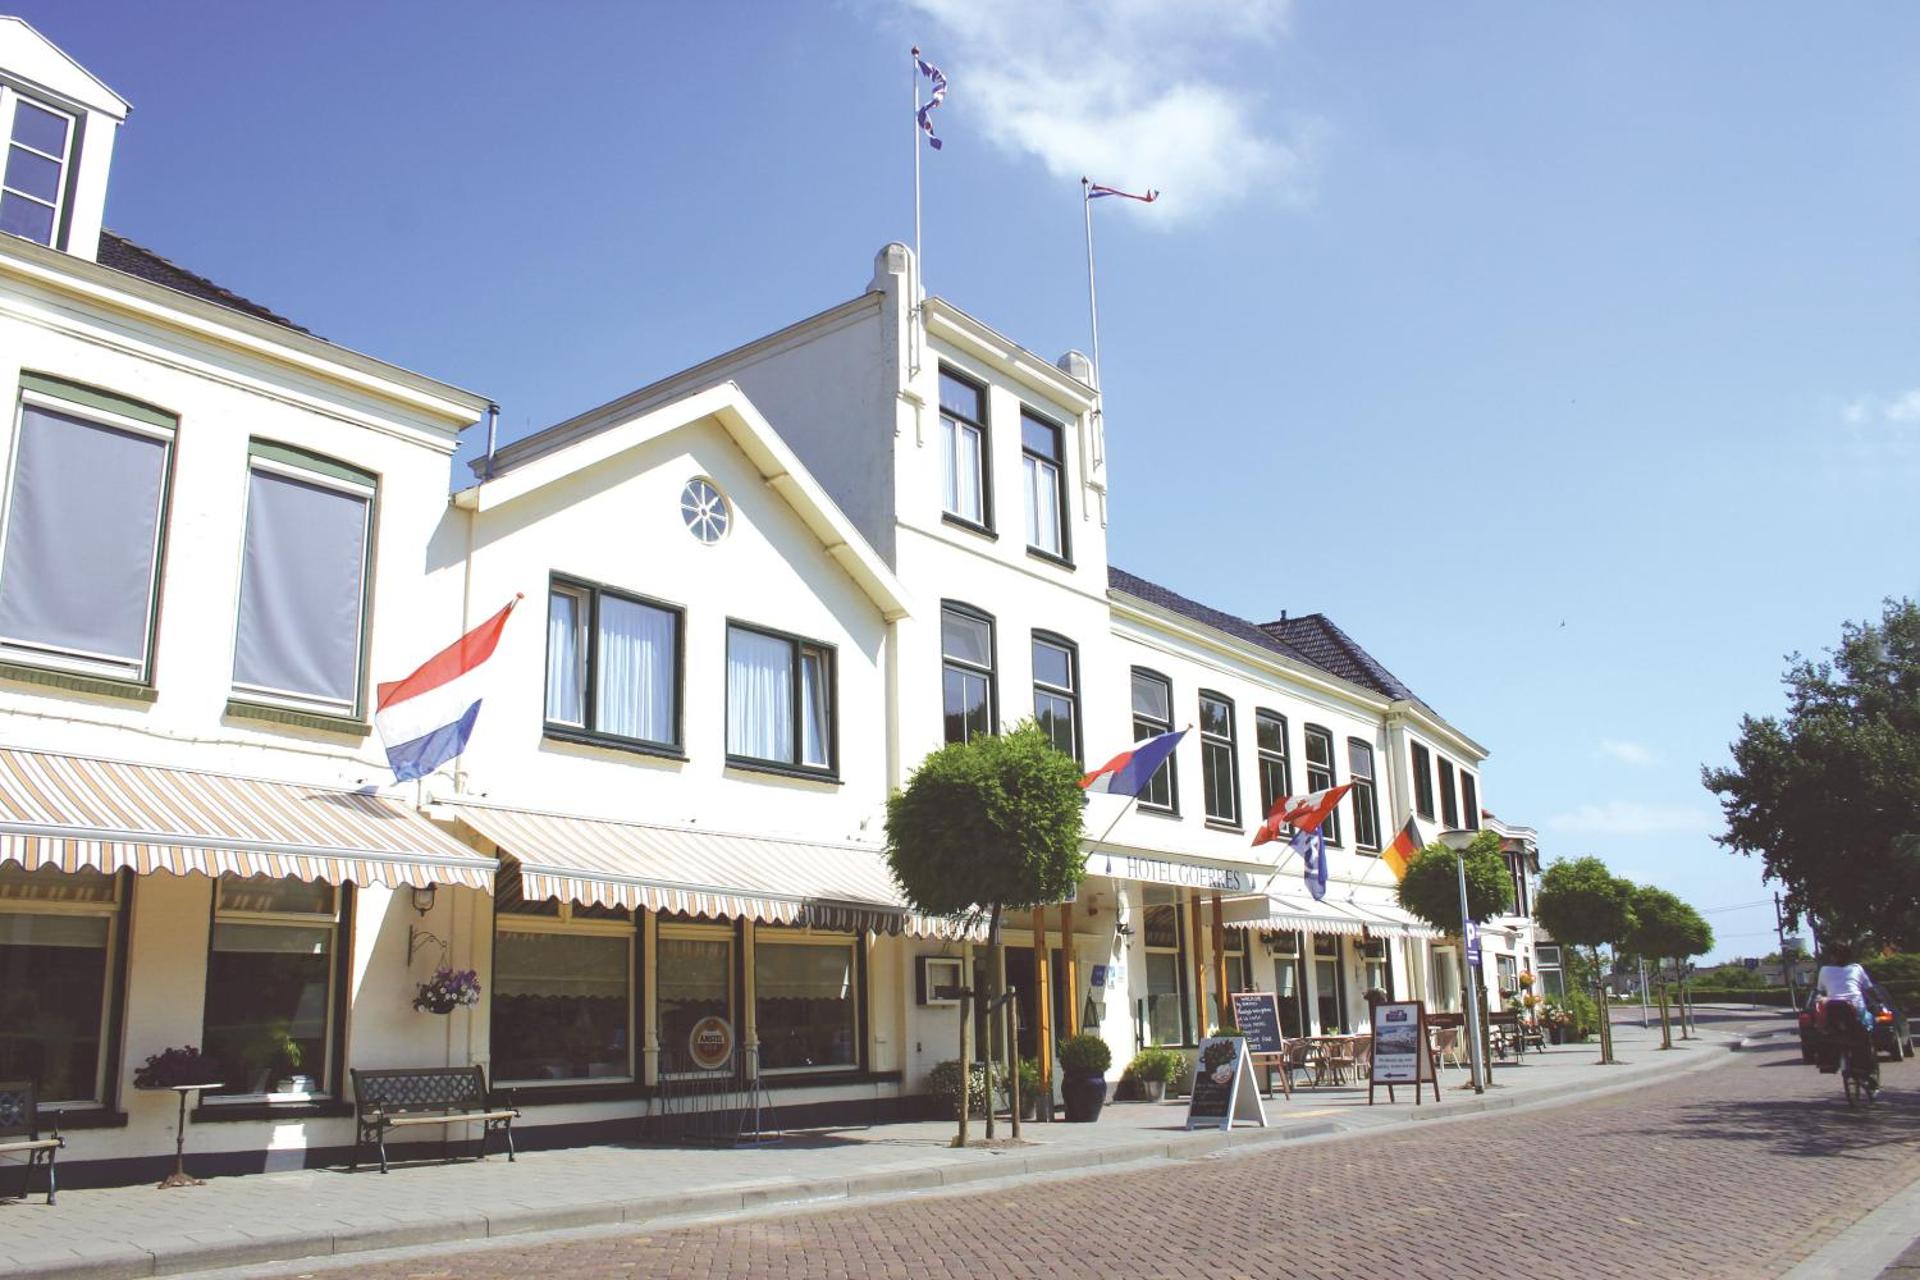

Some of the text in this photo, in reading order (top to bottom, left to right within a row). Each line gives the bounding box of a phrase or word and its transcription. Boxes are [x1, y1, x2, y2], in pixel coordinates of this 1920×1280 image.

[1126, 856, 1241, 890] HOTEL GOERRES
[1466, 922, 1476, 948] P
